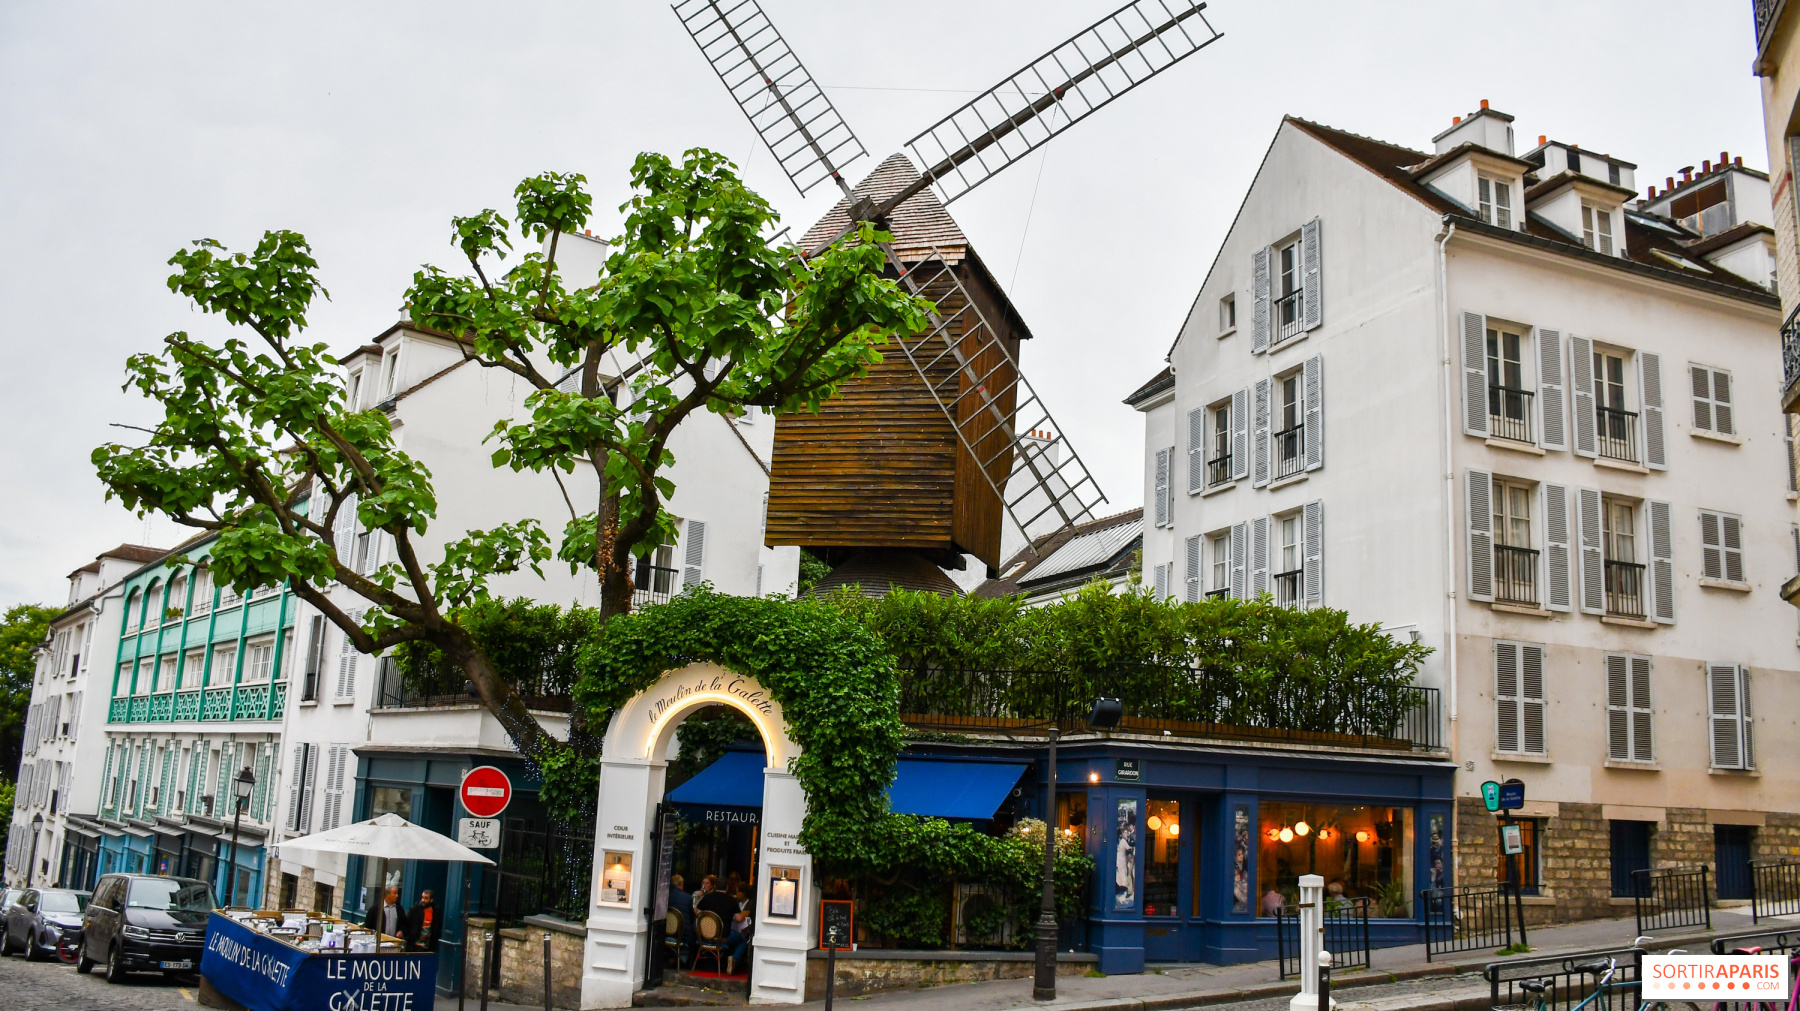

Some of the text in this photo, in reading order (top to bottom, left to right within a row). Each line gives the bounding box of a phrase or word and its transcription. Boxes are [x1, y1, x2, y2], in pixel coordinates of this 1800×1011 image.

[648, 676, 773, 724] le Moulin de la Galette
[469, 820, 492, 829] SAUF
[706, 810, 759, 824] RESTAUR
[767, 831, 788, 839] CUISINE
[208, 931, 220, 951] LE
[216, 934, 241, 963] MOULIN
[240, 946, 252, 968] DE
[251, 950, 261, 972] LA
[327, 959, 421, 980] LE MOULIN
[363, 981, 387, 992] DE LA
[329, 990, 414, 1011] GALETTE
